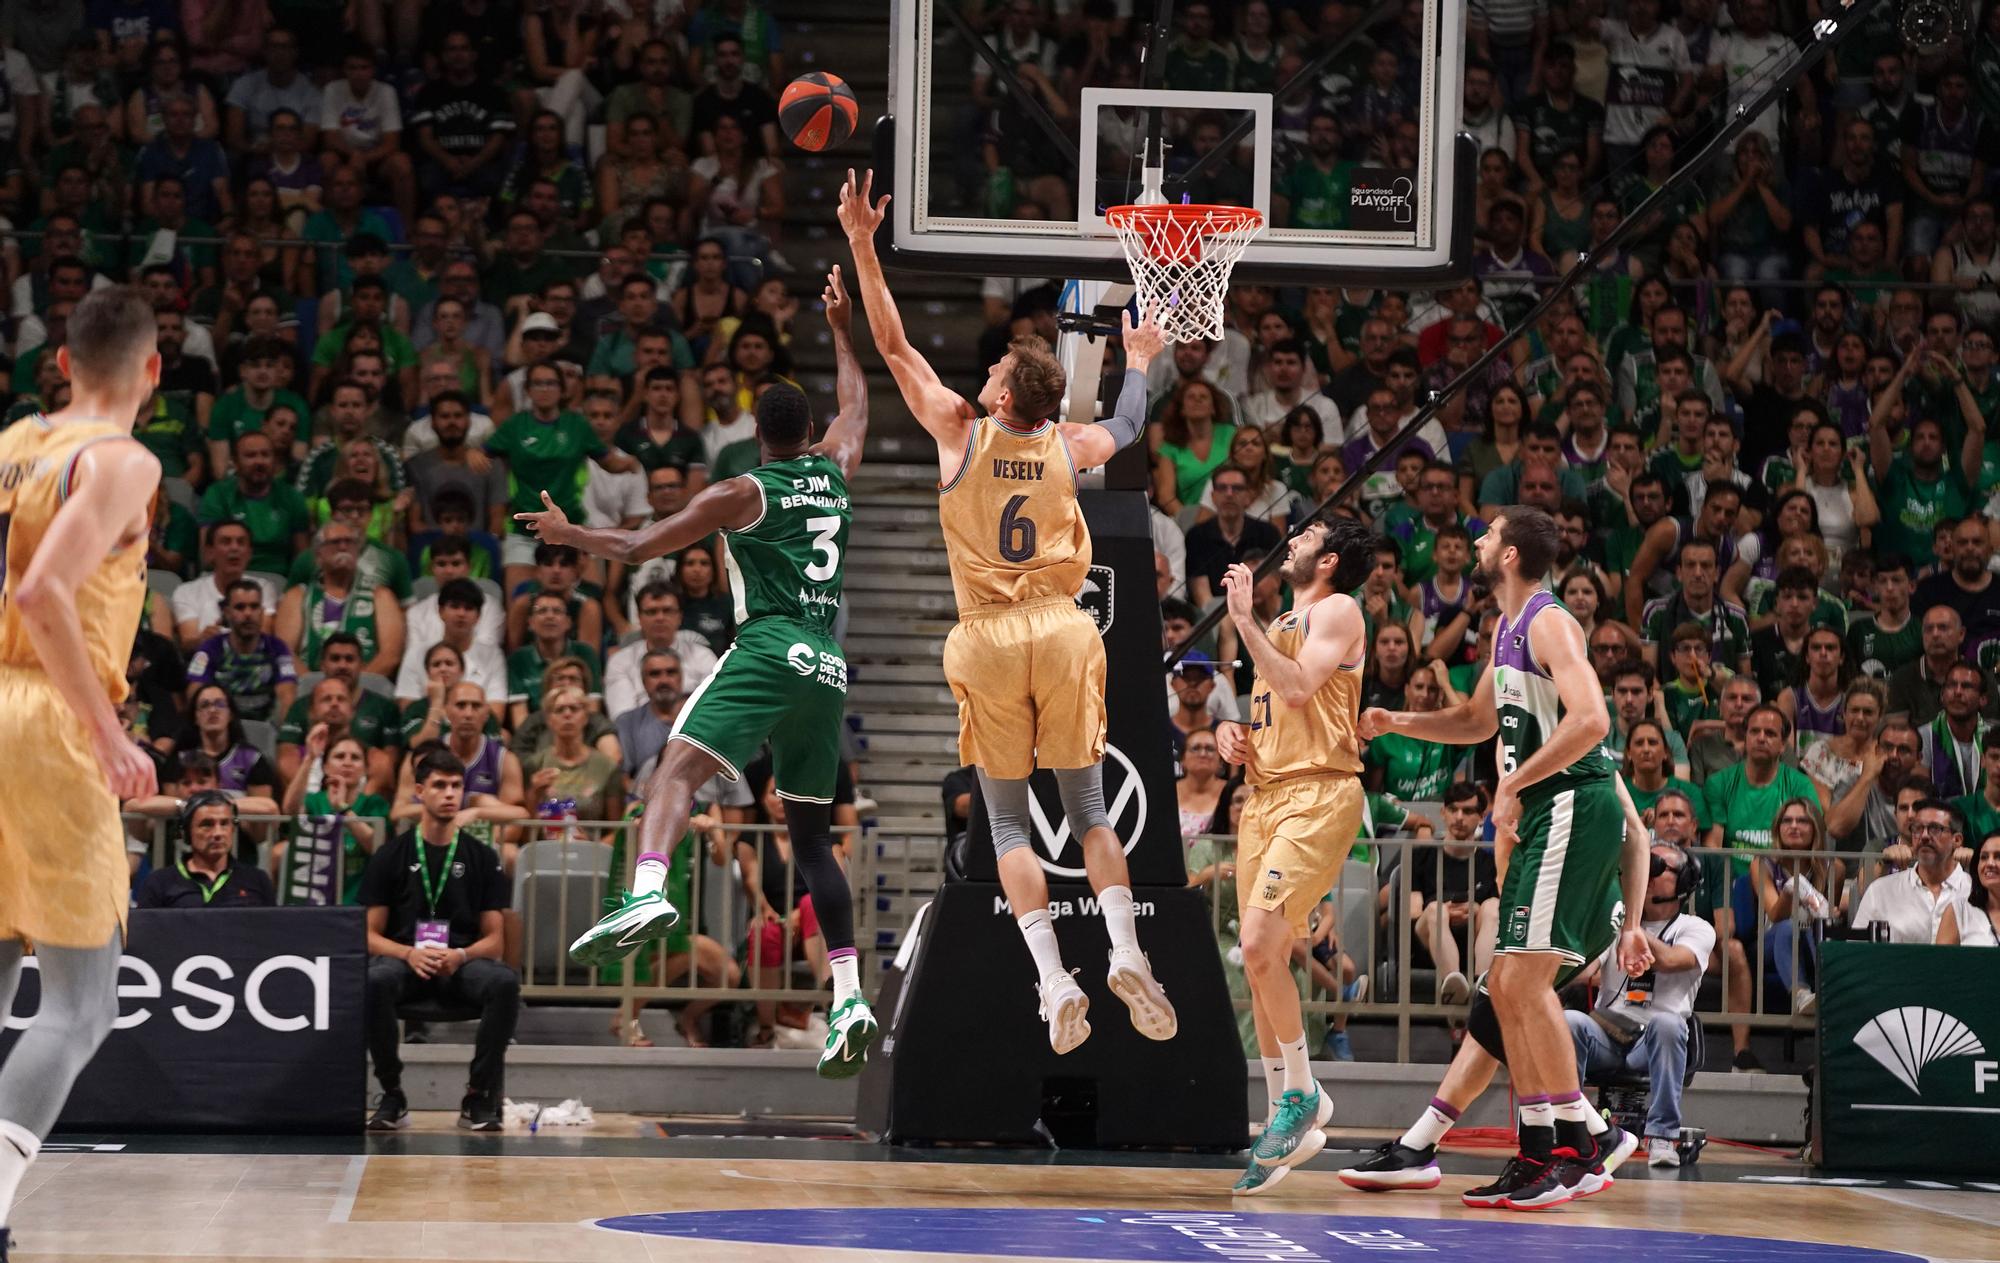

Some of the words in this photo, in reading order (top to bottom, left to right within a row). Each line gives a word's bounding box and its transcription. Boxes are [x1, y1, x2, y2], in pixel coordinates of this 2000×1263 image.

[1351, 195, 1405, 206] PLAYOFF
[993, 458, 1045, 480] VESELY
[793, 474, 831, 494] EJIM
[999, 494, 1036, 563] 6
[804, 515, 842, 582] 3
[820, 662, 838, 676] DEL
[816, 673, 848, 696] MÁLAG
[1251, 691, 1272, 731] 21
[993, 895, 1074, 920] Mga
[1078, 896, 1155, 917] Wen
[5, 954, 330, 1032] esa
